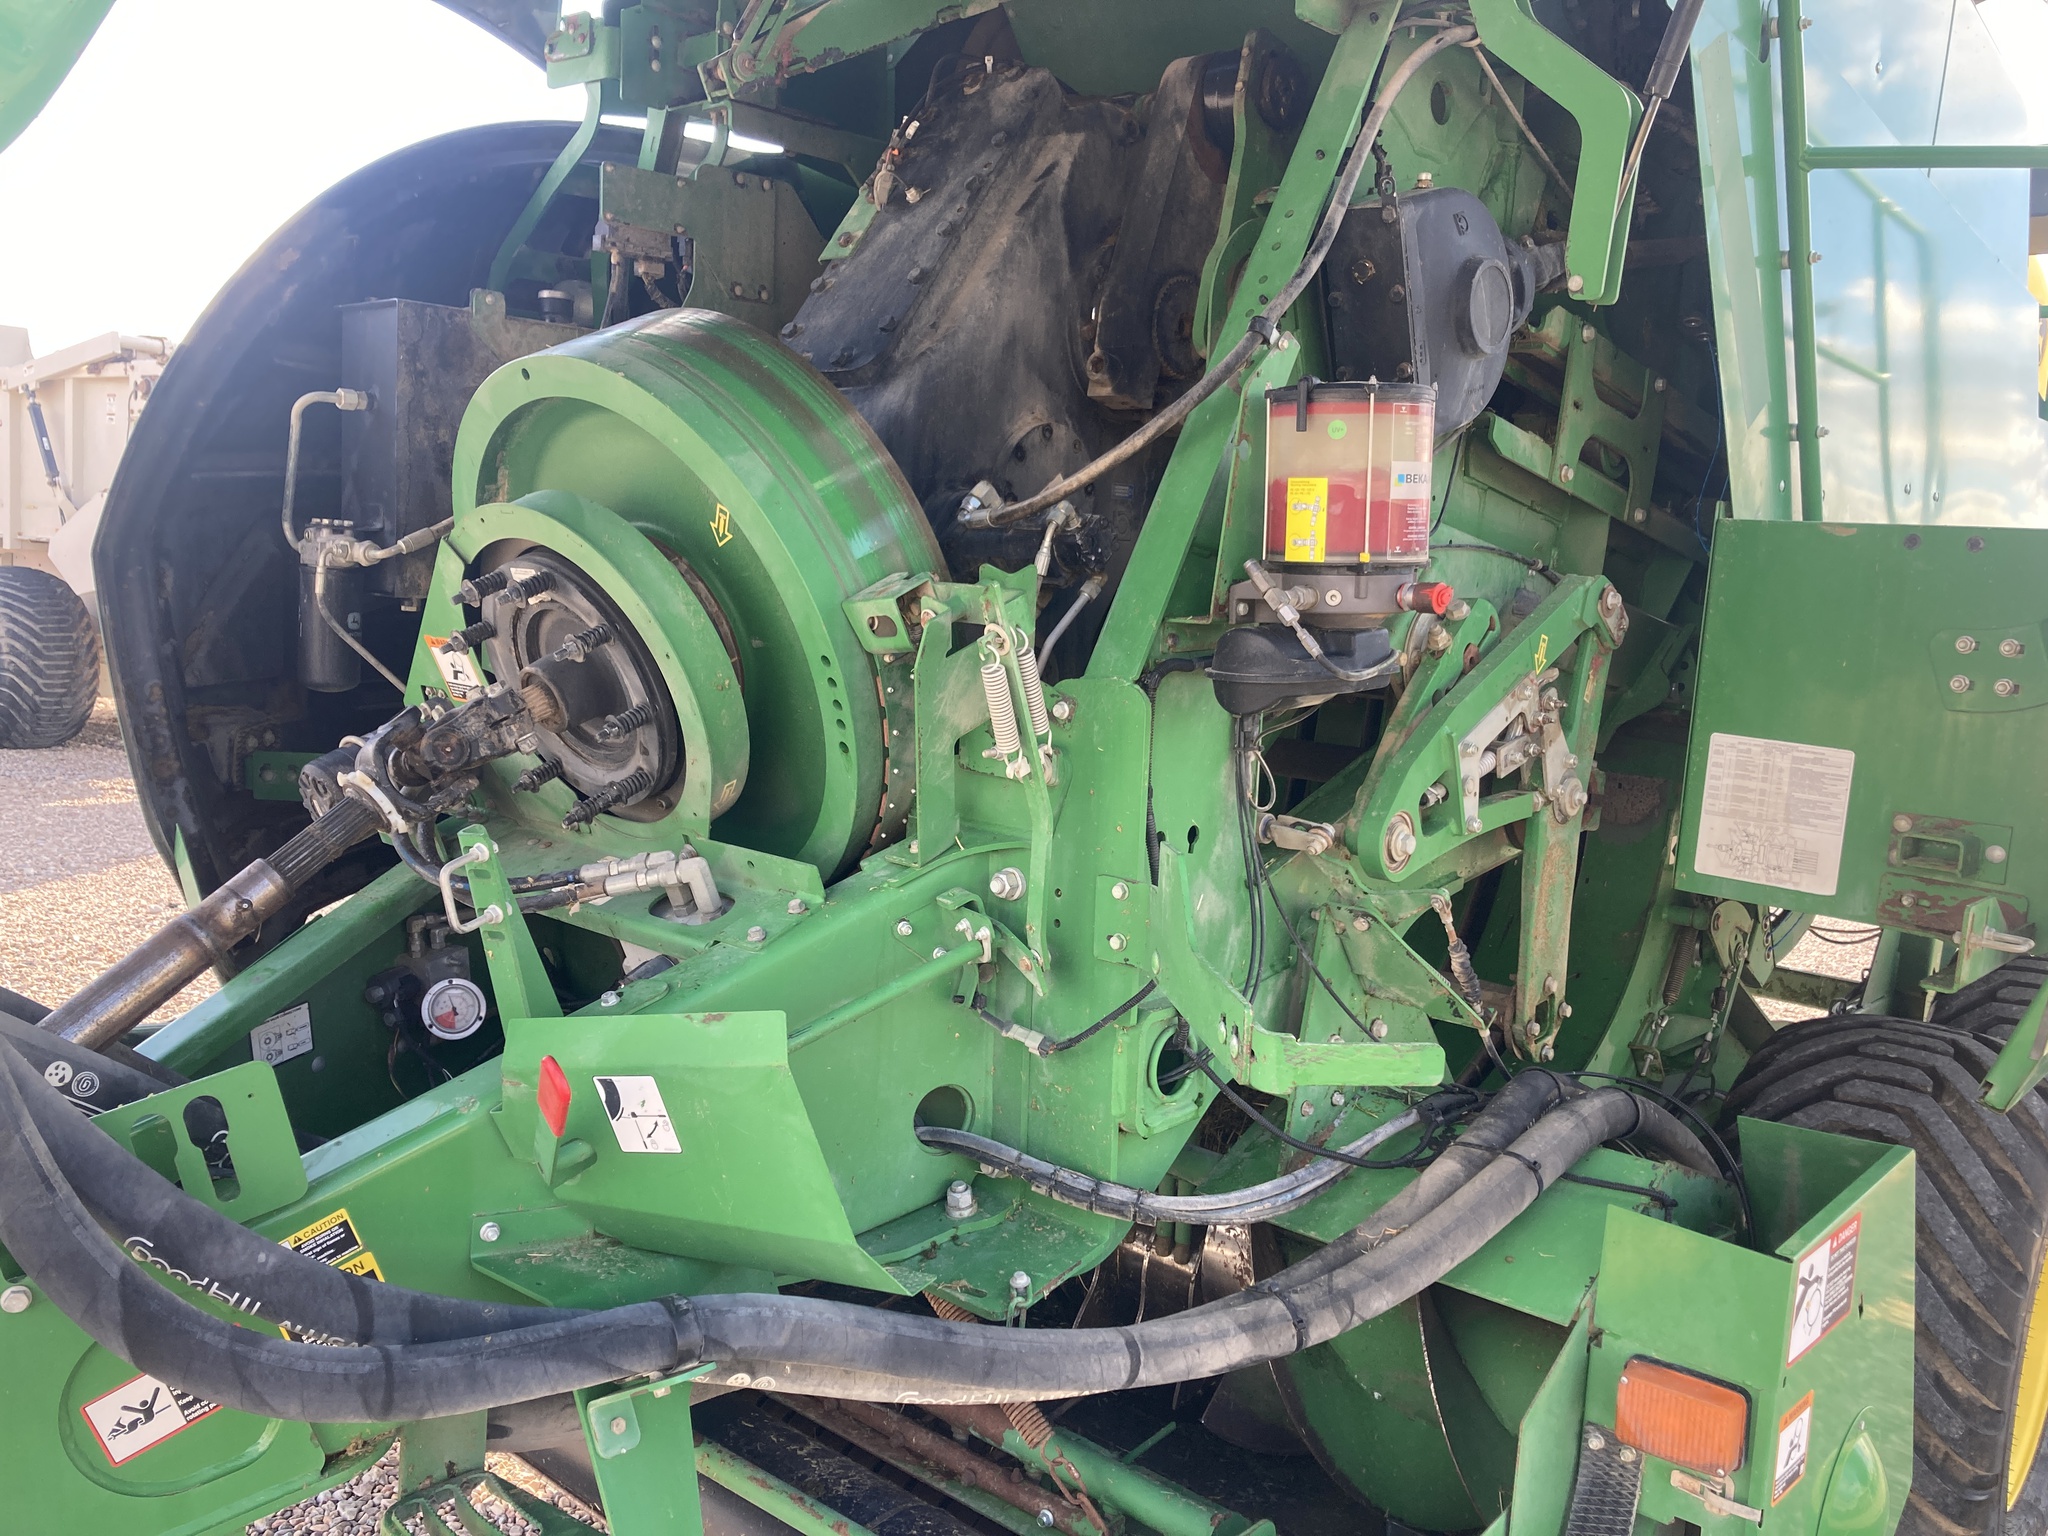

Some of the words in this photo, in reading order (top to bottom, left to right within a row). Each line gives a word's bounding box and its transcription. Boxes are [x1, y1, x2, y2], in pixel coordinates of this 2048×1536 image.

[303, 1213, 344, 1239] CAUTION
[1837, 1220, 1857, 1244] DANGER
[299, 1242, 317, 1254] SMOKE
[316, 1227, 344, 1245] INHALATION
[300, 1239, 316, 1249] AVOID
[177, 1394, 194, 1406] Keep
[183, 1402, 200, 1416] Avoid
[185, 1405, 210, 1421] rotating
